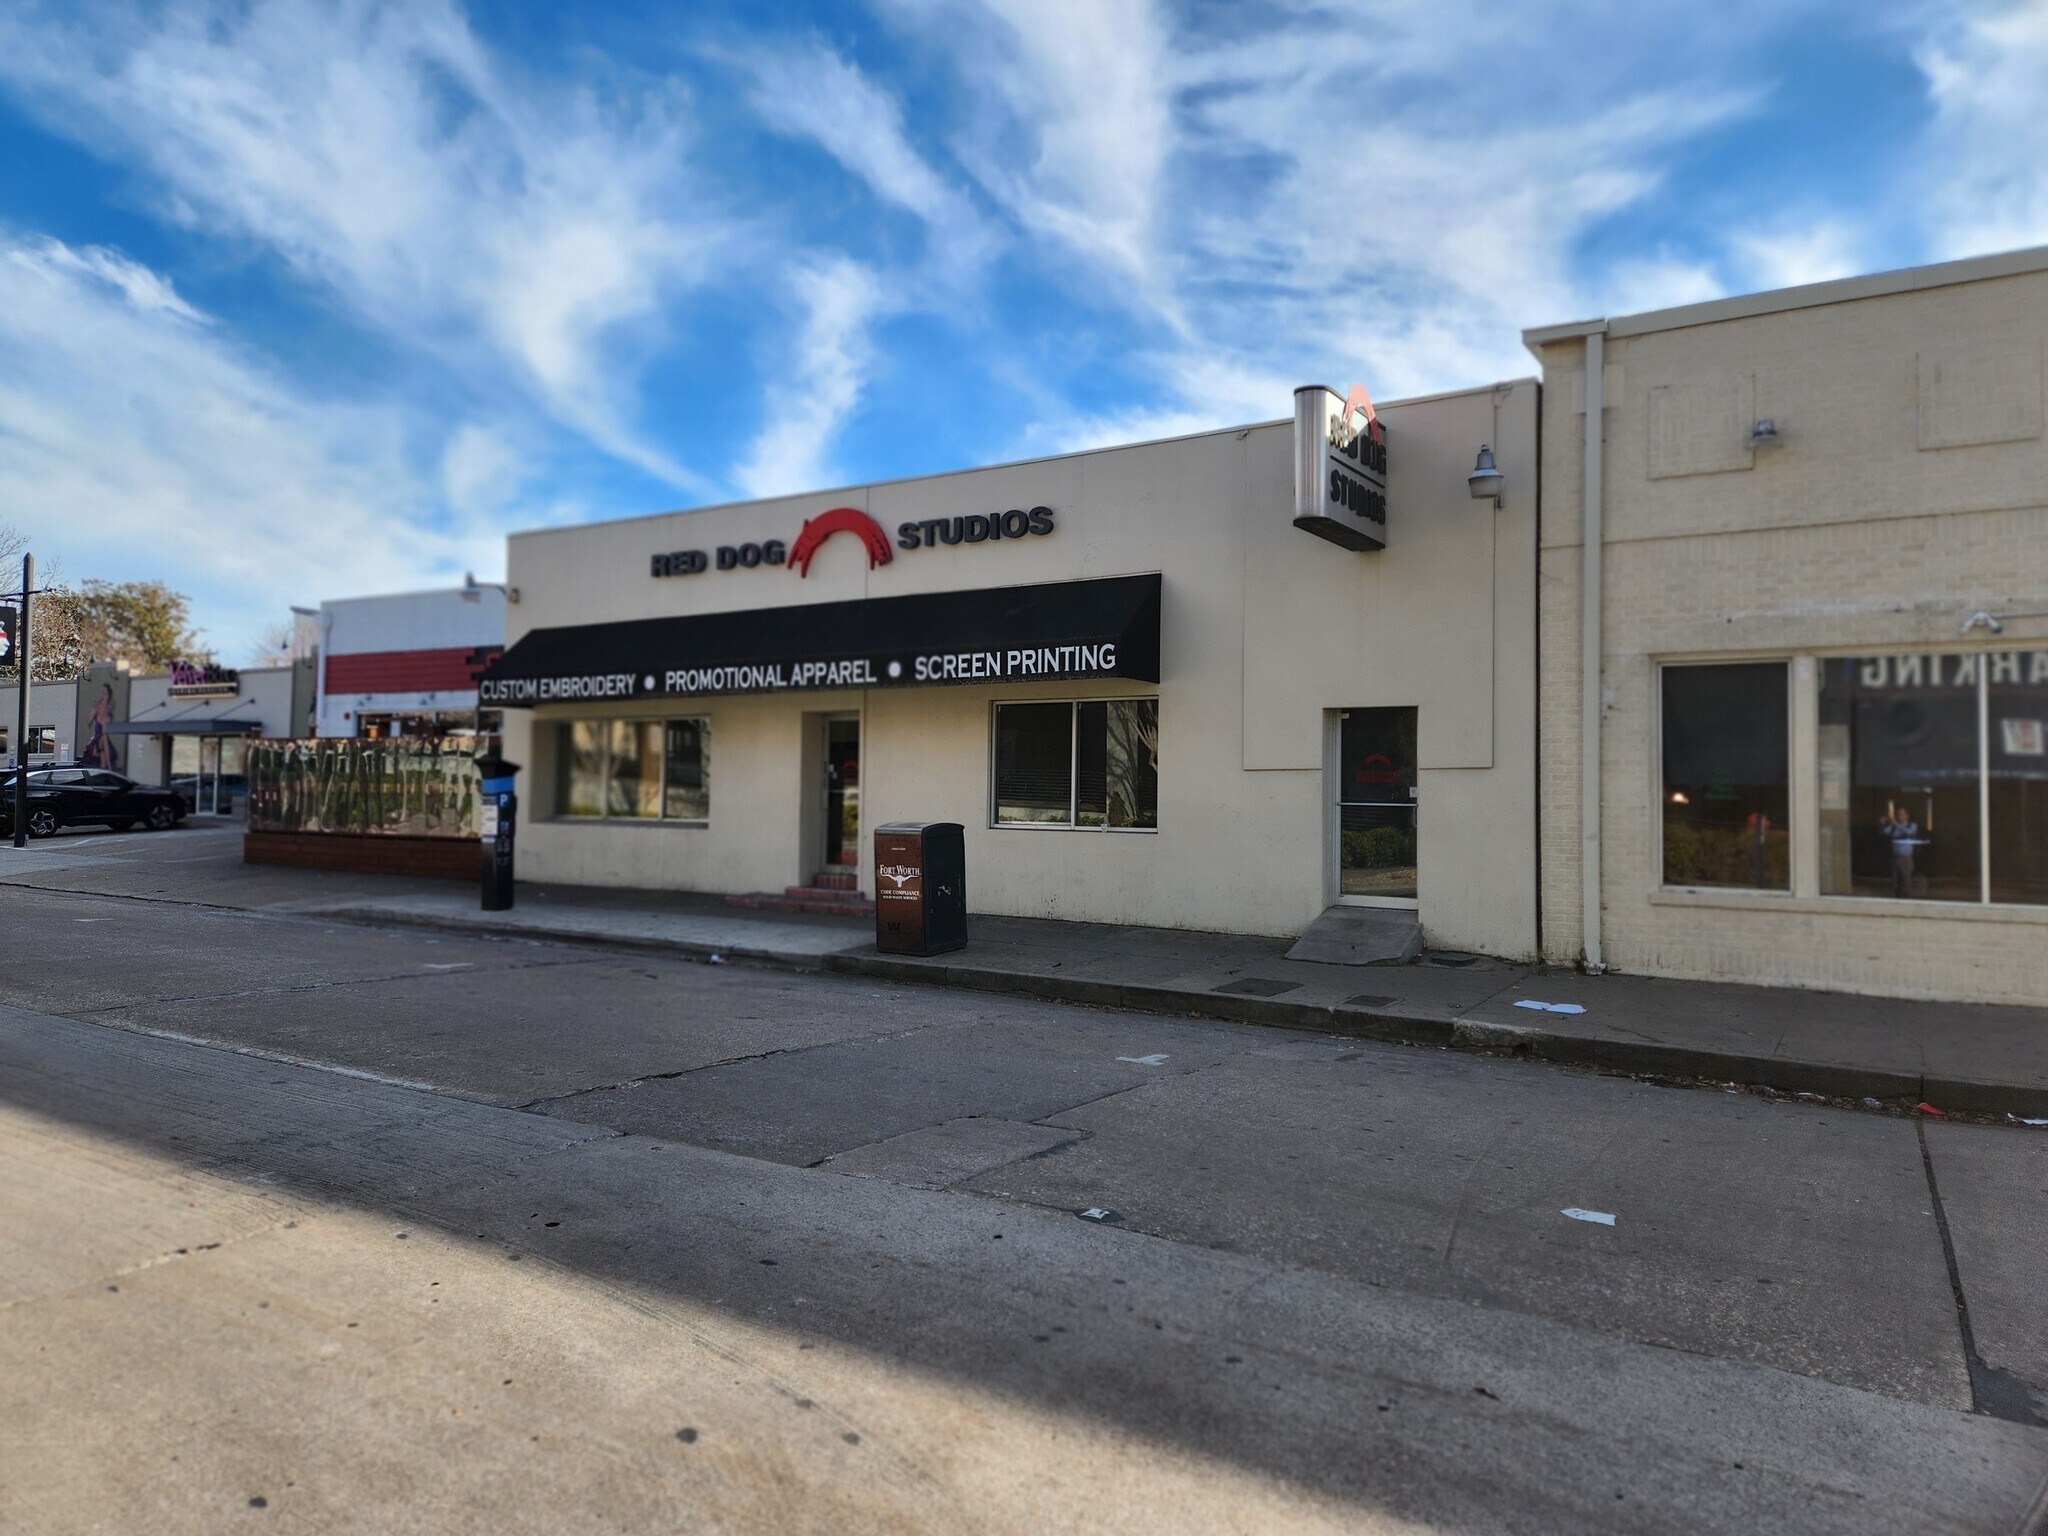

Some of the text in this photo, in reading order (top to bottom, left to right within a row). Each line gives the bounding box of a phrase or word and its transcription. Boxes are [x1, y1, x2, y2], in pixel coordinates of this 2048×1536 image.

[1329, 468, 1387, 526] STUDIOS
[651, 505, 1055, 578] RED DOG STUDIOS
[480, 643, 1117, 699] CUSTOM EMBROIDERY PROMOTIONAL APPAREL SCREEN PRINTING
[880, 865, 920, 875] FORT WORTH
